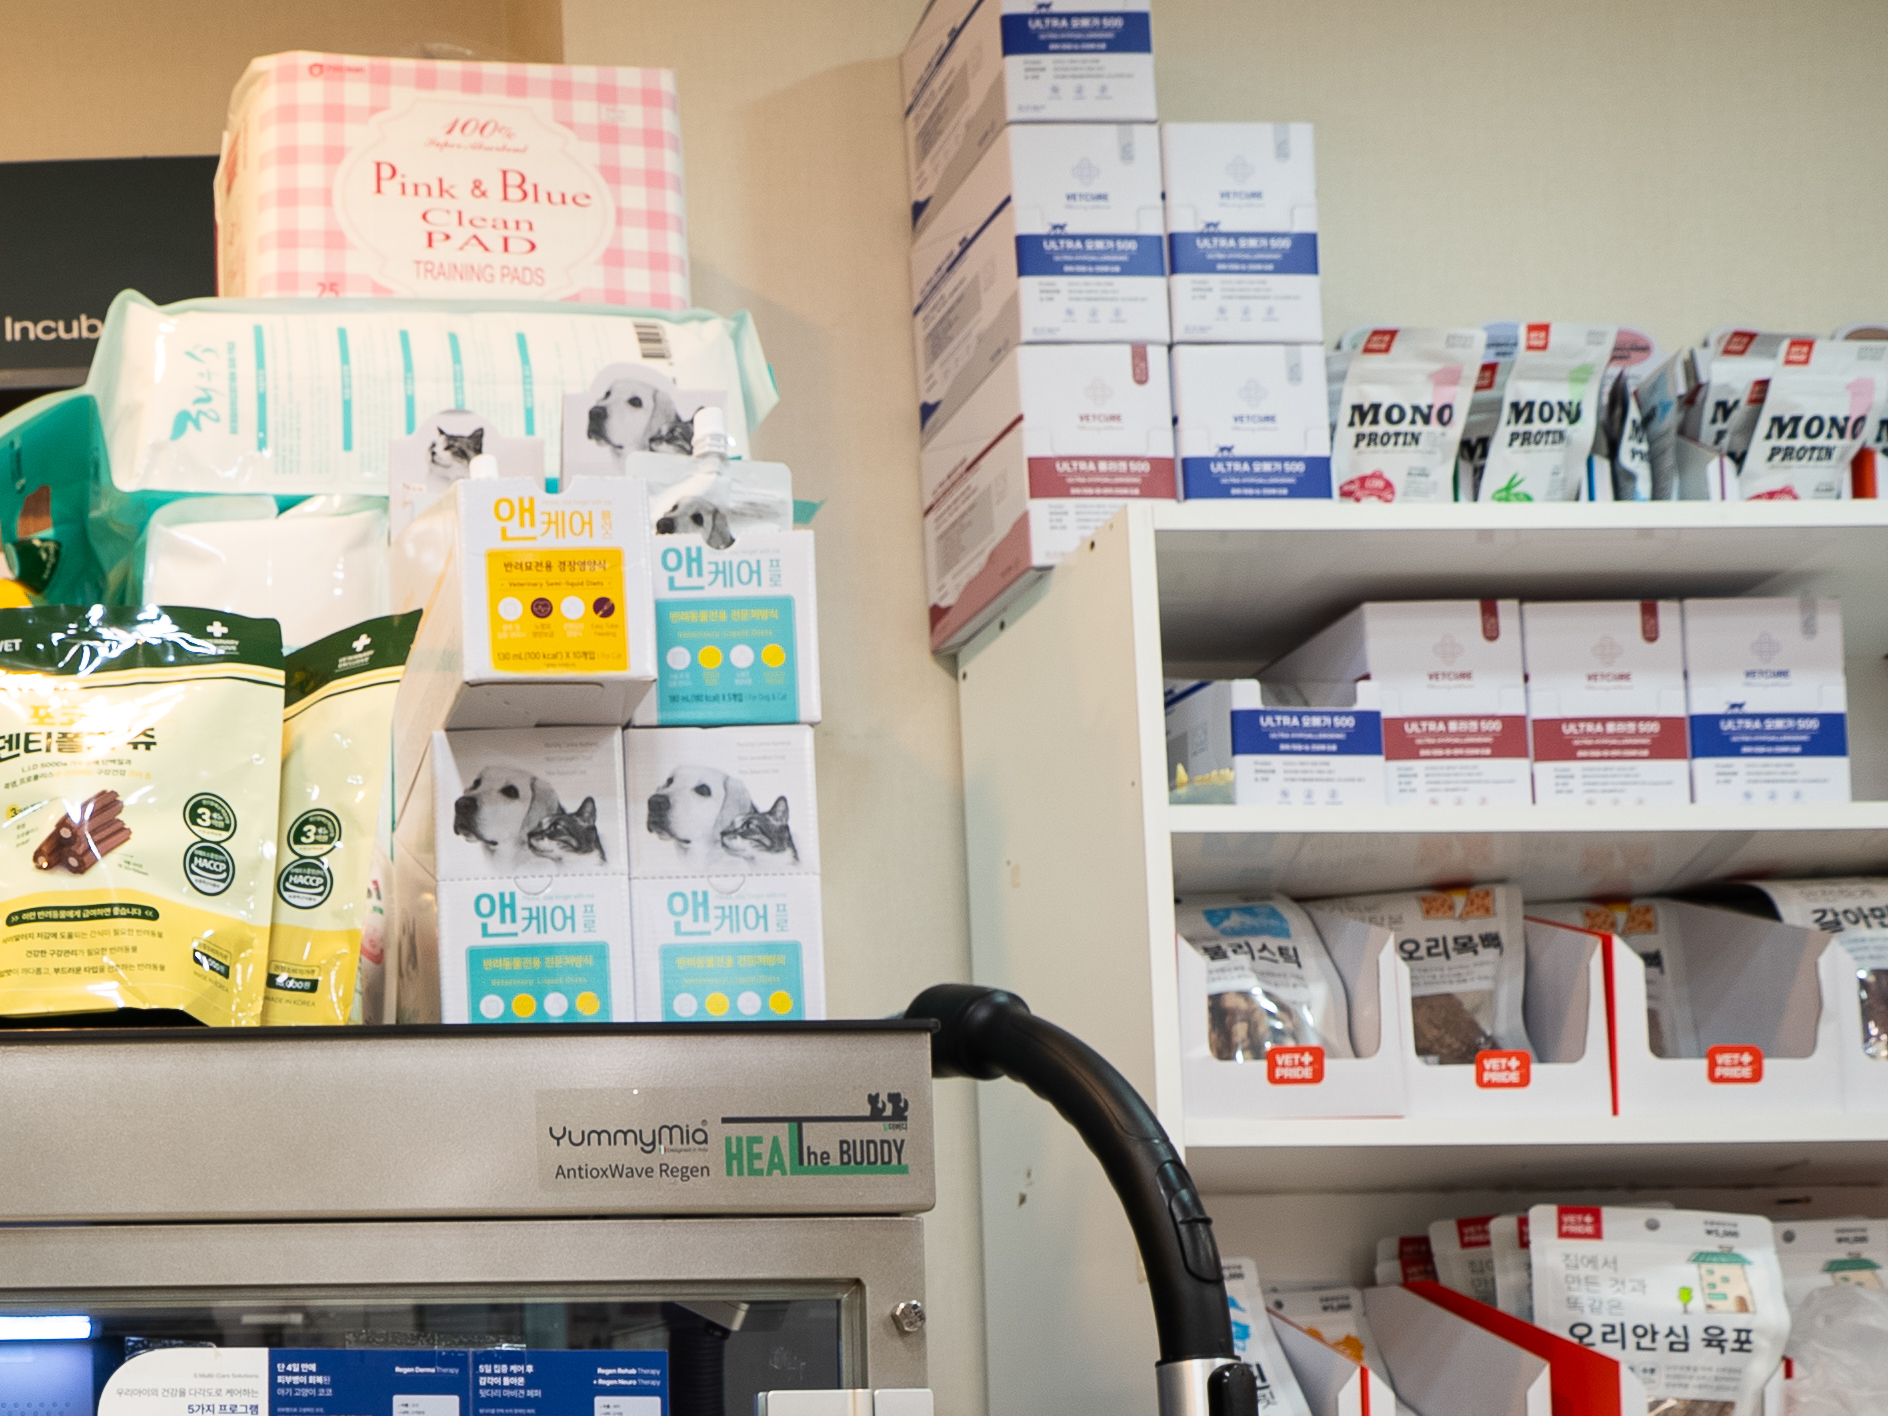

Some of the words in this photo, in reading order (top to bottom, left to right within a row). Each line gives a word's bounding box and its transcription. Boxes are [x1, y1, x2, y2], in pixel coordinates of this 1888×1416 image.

[373, 160, 458, 199] Pink
[471, 178, 488, 199] &
[499, 168, 592, 208] Blue
[421, 208, 534, 232] Clean
[425, 231, 536, 255] PAD
[414, 260, 495, 284] TRAINING
[500, 264, 545, 286] PADS
[6, 314, 103, 342] Incub
[1348, 402, 1454, 427] MONO
[1353, 430, 1421, 448] PROTIN
[1763, 414, 1867, 440] MONO
[494, 496, 594, 541] 앤케어
[661, 546, 762, 591] 앤케어
[193, 856, 227, 872] HACCP
[288, 874, 324, 887] HACCP
[474, 891, 576, 938] 앤케어
[667, 890, 769, 936] 앤케어
[1275, 1053, 1300, 1066] VET
[1483, 1057, 1507, 1070] VET
[1275, 1067, 1313, 1080] PRIDE
[1483, 1070, 1520, 1083] PRIDE
[549, 1123, 709, 1154] YummyMia
[839, 1138, 905, 1166] BUDDY
[555, 1163, 654, 1180] AntioxWave
[659, 1163, 711, 1182] Regen
[1569, 1322, 1689, 1353] 오리안심
[1701, 1325, 1754, 1354] 육포
[116, 1388, 159, 1398] 우리아이의
[161, 1388, 186, 1398] 건강을
[189, 1388, 223, 1398] 다각도로
[226, 1388, 259, 1398] 케어하는
[187, 1404, 215, 1415] 5가지
[218, 1404, 259, 1415] 프로그램
